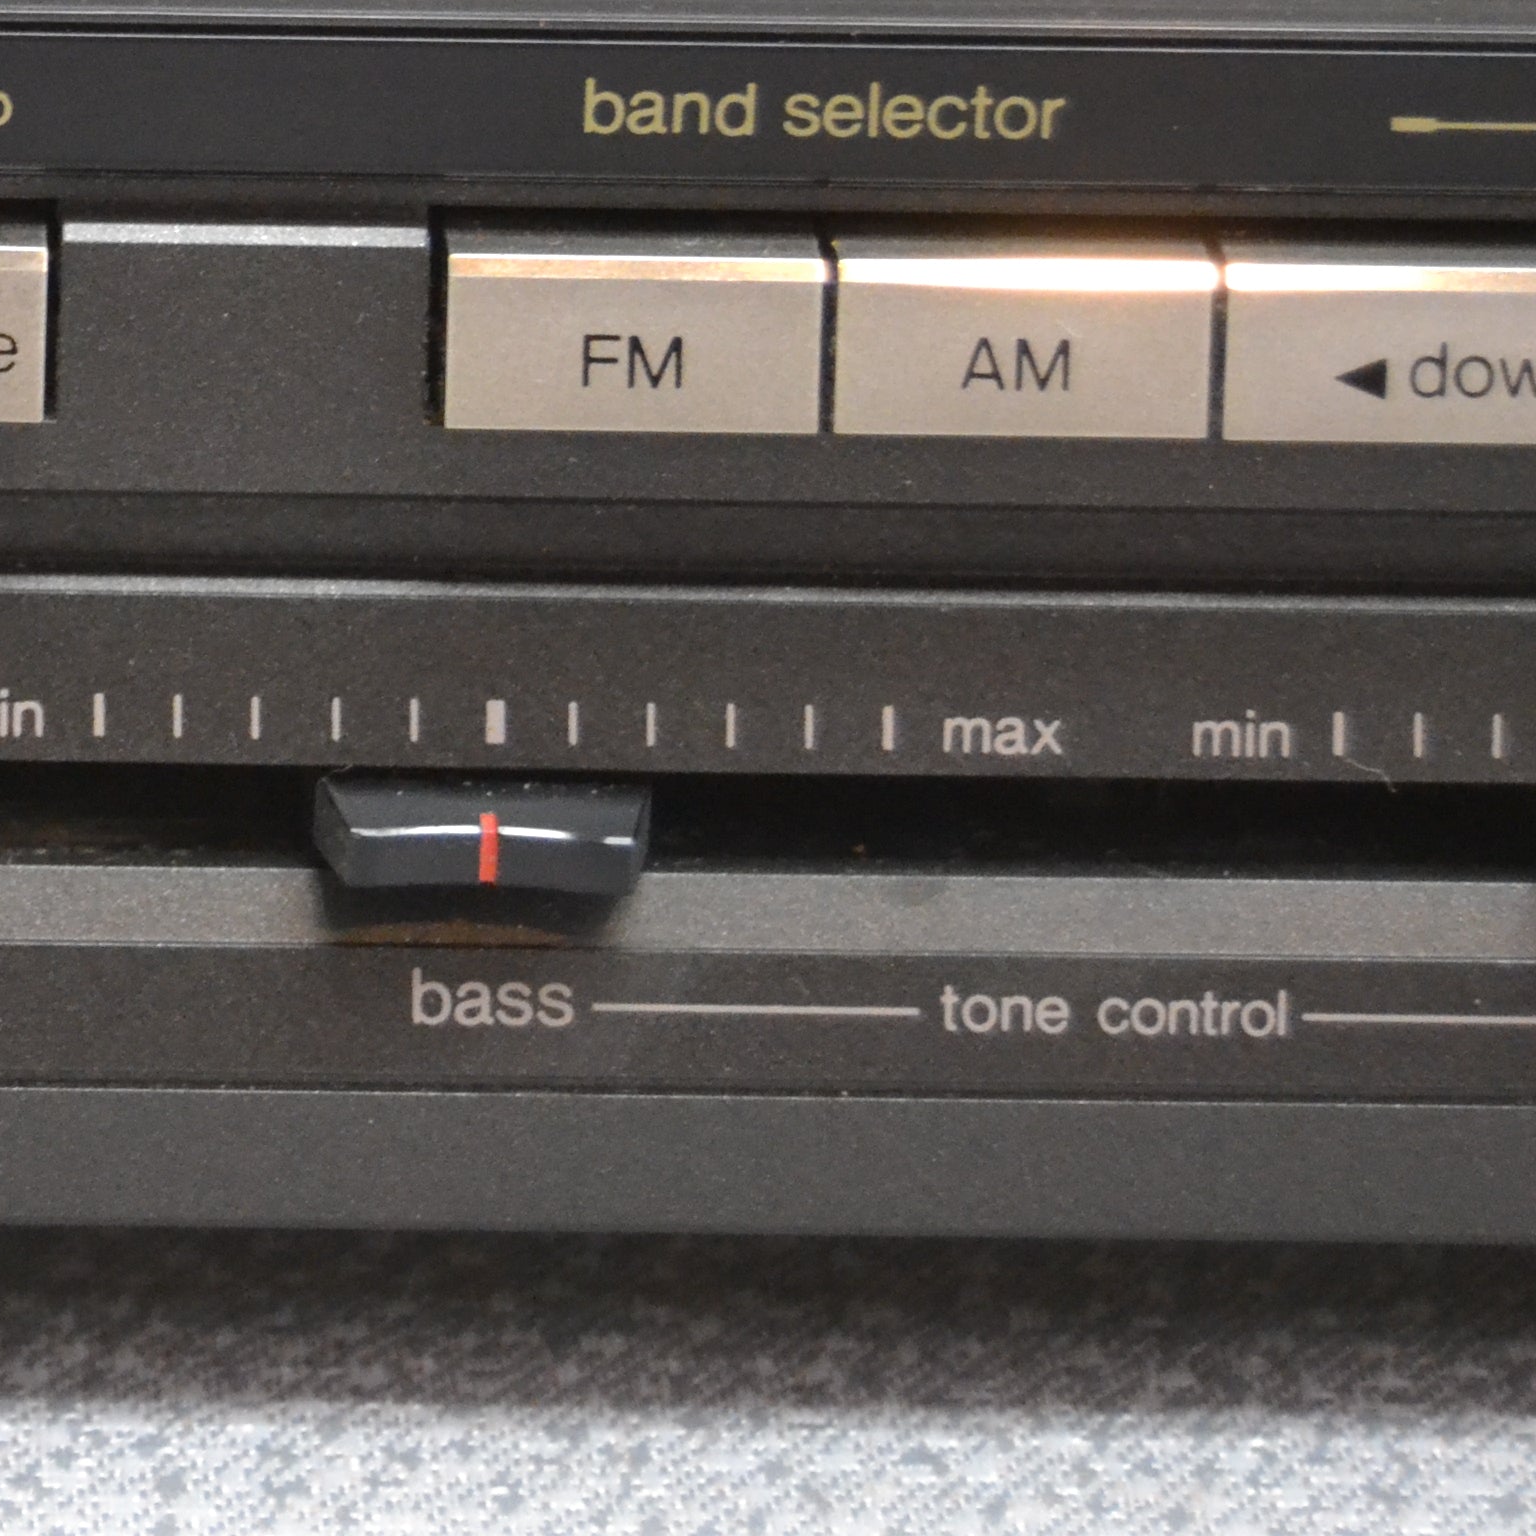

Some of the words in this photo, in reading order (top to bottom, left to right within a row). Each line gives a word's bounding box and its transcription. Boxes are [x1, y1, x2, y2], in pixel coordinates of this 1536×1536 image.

[582, 76, 759, 138] band
[781, 80, 1068, 141] selector
[581, 332, 685, 390] FM
[960, 336, 1072, 393] AM
[941, 715, 1064, 757] max
[1191, 708, 1293, 759] min
[410, 967, 576, 1029] bass
[939, 983, 1072, 1036] tone
[1096, 988, 1289, 1039] control
